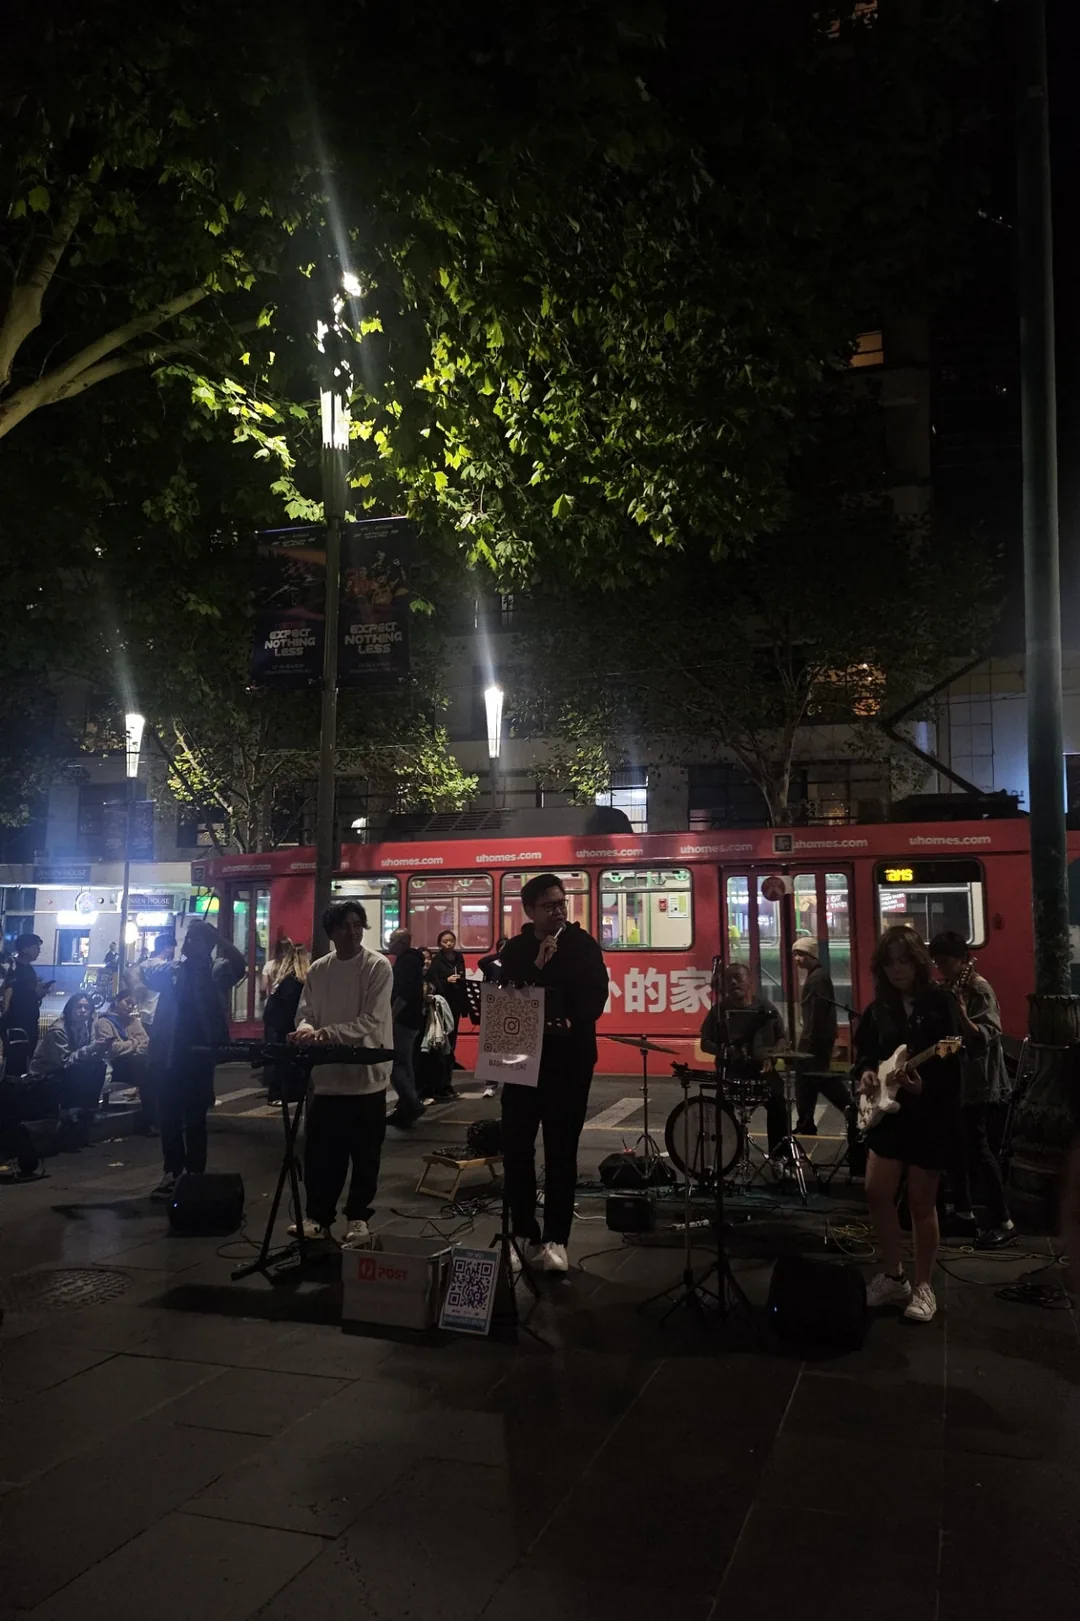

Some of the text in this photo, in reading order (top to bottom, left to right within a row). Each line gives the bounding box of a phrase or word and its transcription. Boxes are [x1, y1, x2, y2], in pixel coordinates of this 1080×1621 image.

[269, 628, 311, 640] EXPECT
[350, 621, 397, 635] EXPECT
[264, 636, 316, 650] NOTHING
[344, 631, 402, 645] NOTHING
[274, 647, 304, 657] LESS
[358, 643, 391, 655] LESS
[909, 835, 991, 845] uhomes.com
[576, 848, 643, 858] uhomes.com
[680, 843, 752, 854] uhomes.com
[381, 856, 443, 867] uhomes.com
[475, 851, 542, 863] uhomes.com
[378, 1266, 408, 1280] POST
